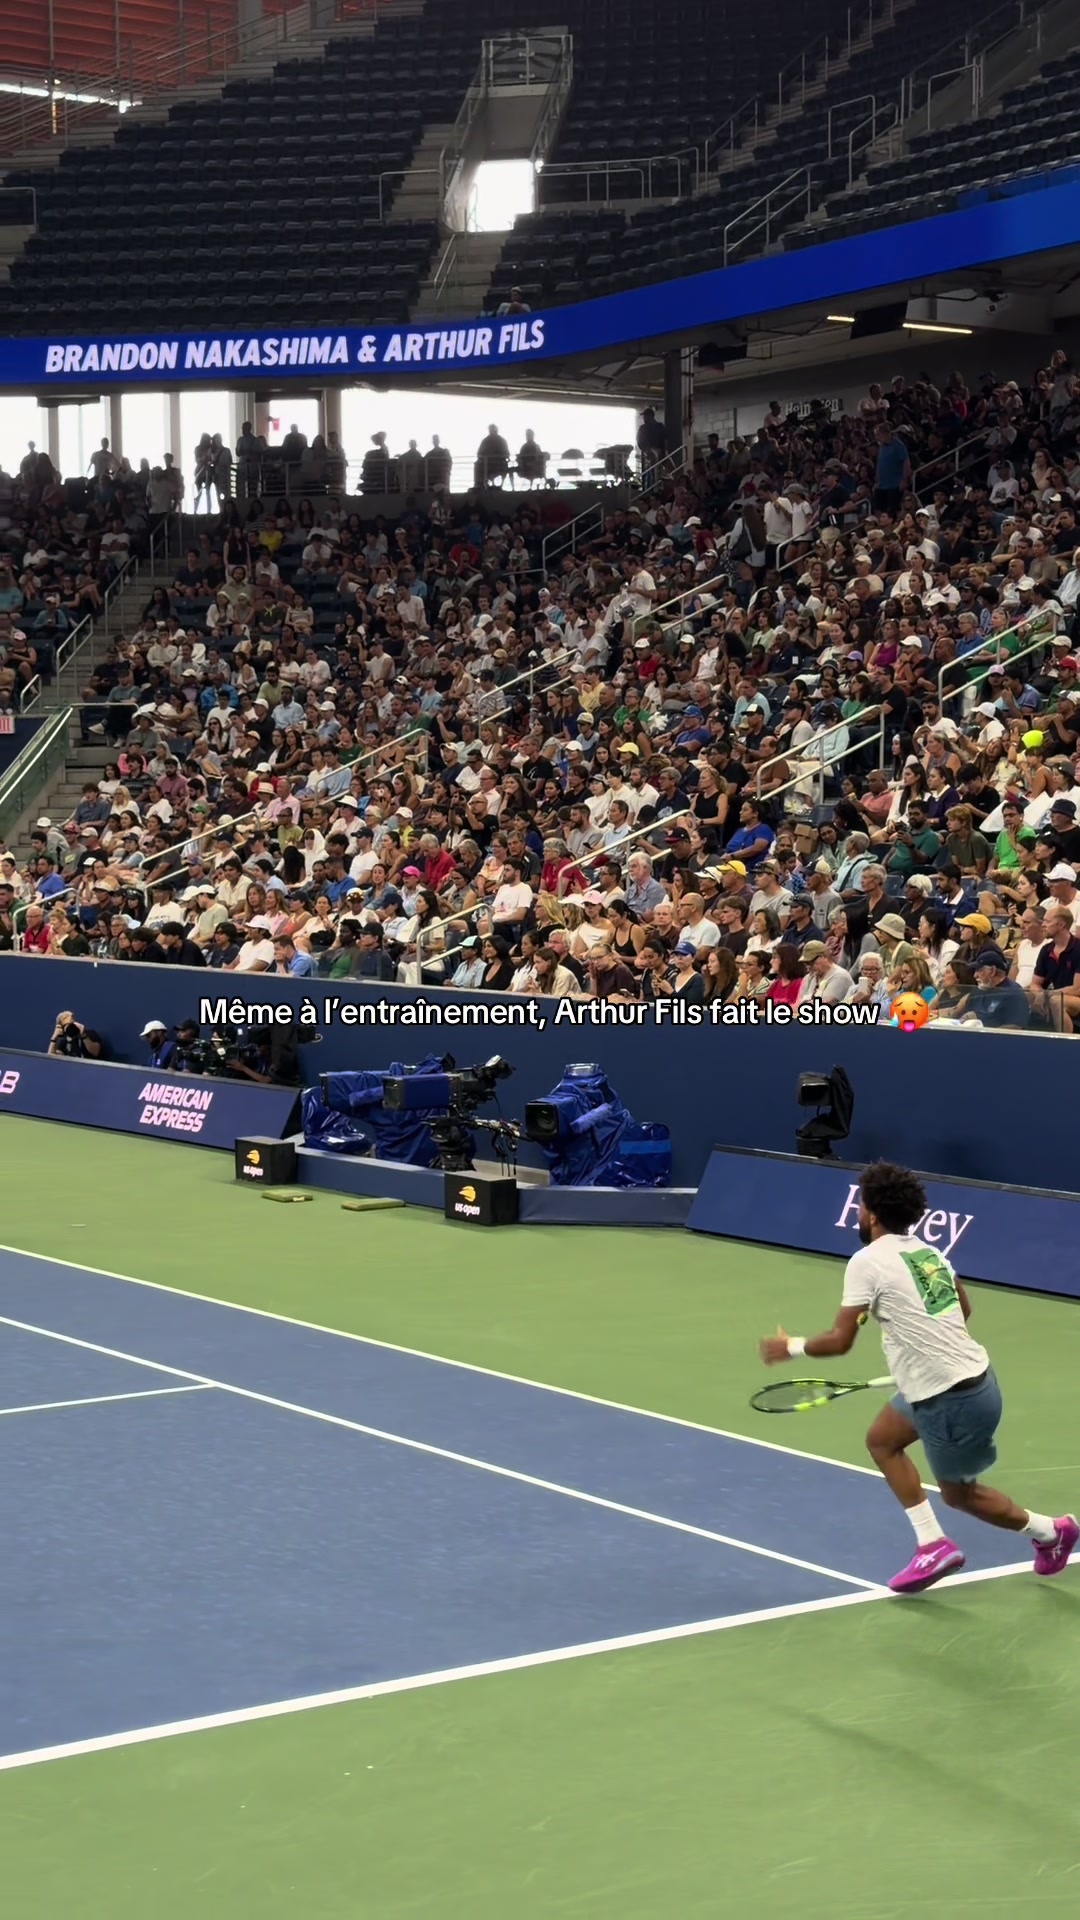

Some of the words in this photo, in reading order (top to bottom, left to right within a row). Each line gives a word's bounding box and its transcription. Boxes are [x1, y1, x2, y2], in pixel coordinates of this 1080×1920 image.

[45, 341, 179, 373] BRANDON
[184, 335, 349, 369] NAKASHIMA
[357, 335, 376, 363] &
[383, 327, 493, 362] ARTHUR
[498, 319, 545, 354] FILS
[785, 399, 839, 417] Heinen
[138, 1083, 213, 1110] AMERICAN
[140, 1105, 205, 1132] EXPRESS
[835, 1184, 974, 1256] Hvey
